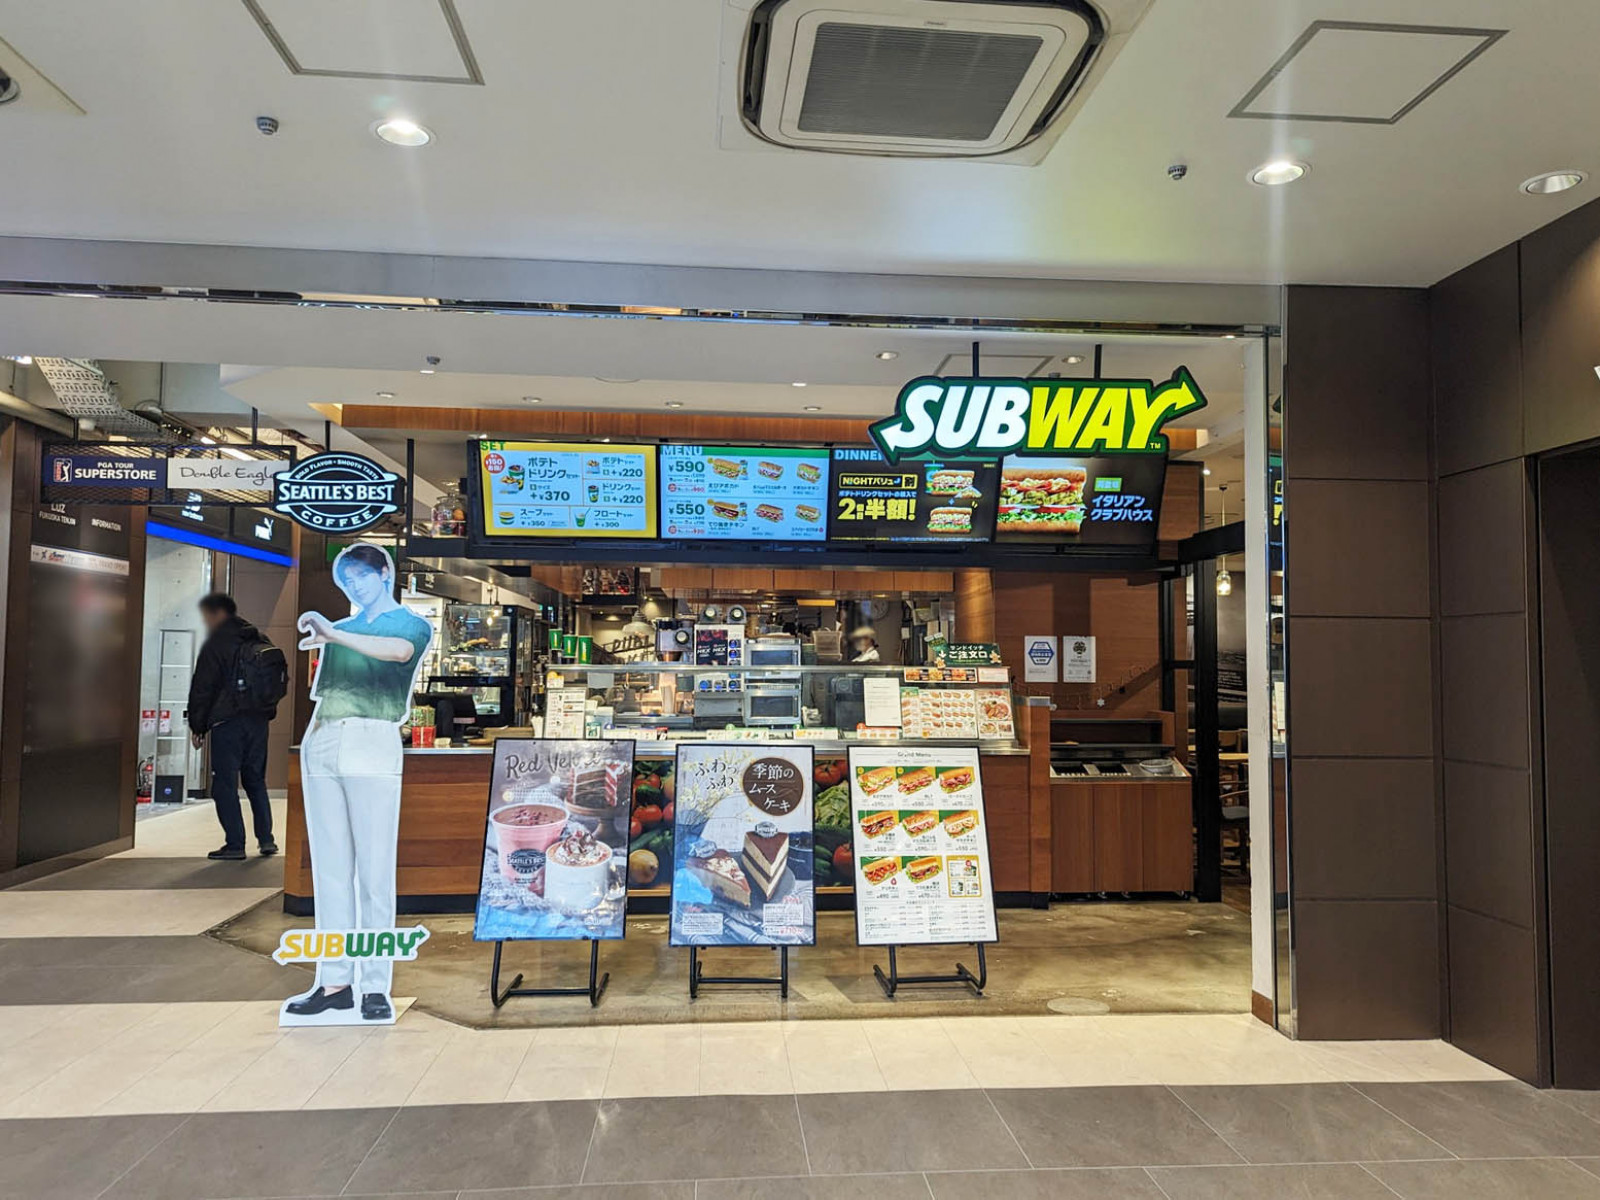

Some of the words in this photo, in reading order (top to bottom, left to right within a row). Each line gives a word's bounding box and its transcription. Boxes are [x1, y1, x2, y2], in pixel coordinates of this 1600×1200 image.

[880, 381, 1196, 452] SUBWAY
[480, 441, 506, 452] SET
[661, 446, 703, 456] MENU
[180, 466, 232, 479] Double
[295, 467, 310, 480] BOLD
[310, 459, 333, 471] FLAVOR
[337, 459, 362, 470] SMOOTH
[362, 464, 380, 480] TASTE
[668, 460, 705, 473] ¥590
[74, 468, 157, 480] SUPERSTORE
[278, 483, 354, 501] SEATTLE'S
[356, 484, 395, 502] BEST
[1091, 495, 1146, 508] イタリアン
[668, 503, 705, 515] ¥550
[1089, 508, 1154, 522] クラブハウス
[301, 509, 373, 528] COFFEE
[505, 752, 543, 779] Red
[752, 762, 794, 780] 季節の
[749, 783, 776, 795] ムース
[764, 797, 791, 813] ケーキ
[277, 930, 426, 959] SUBWAY
